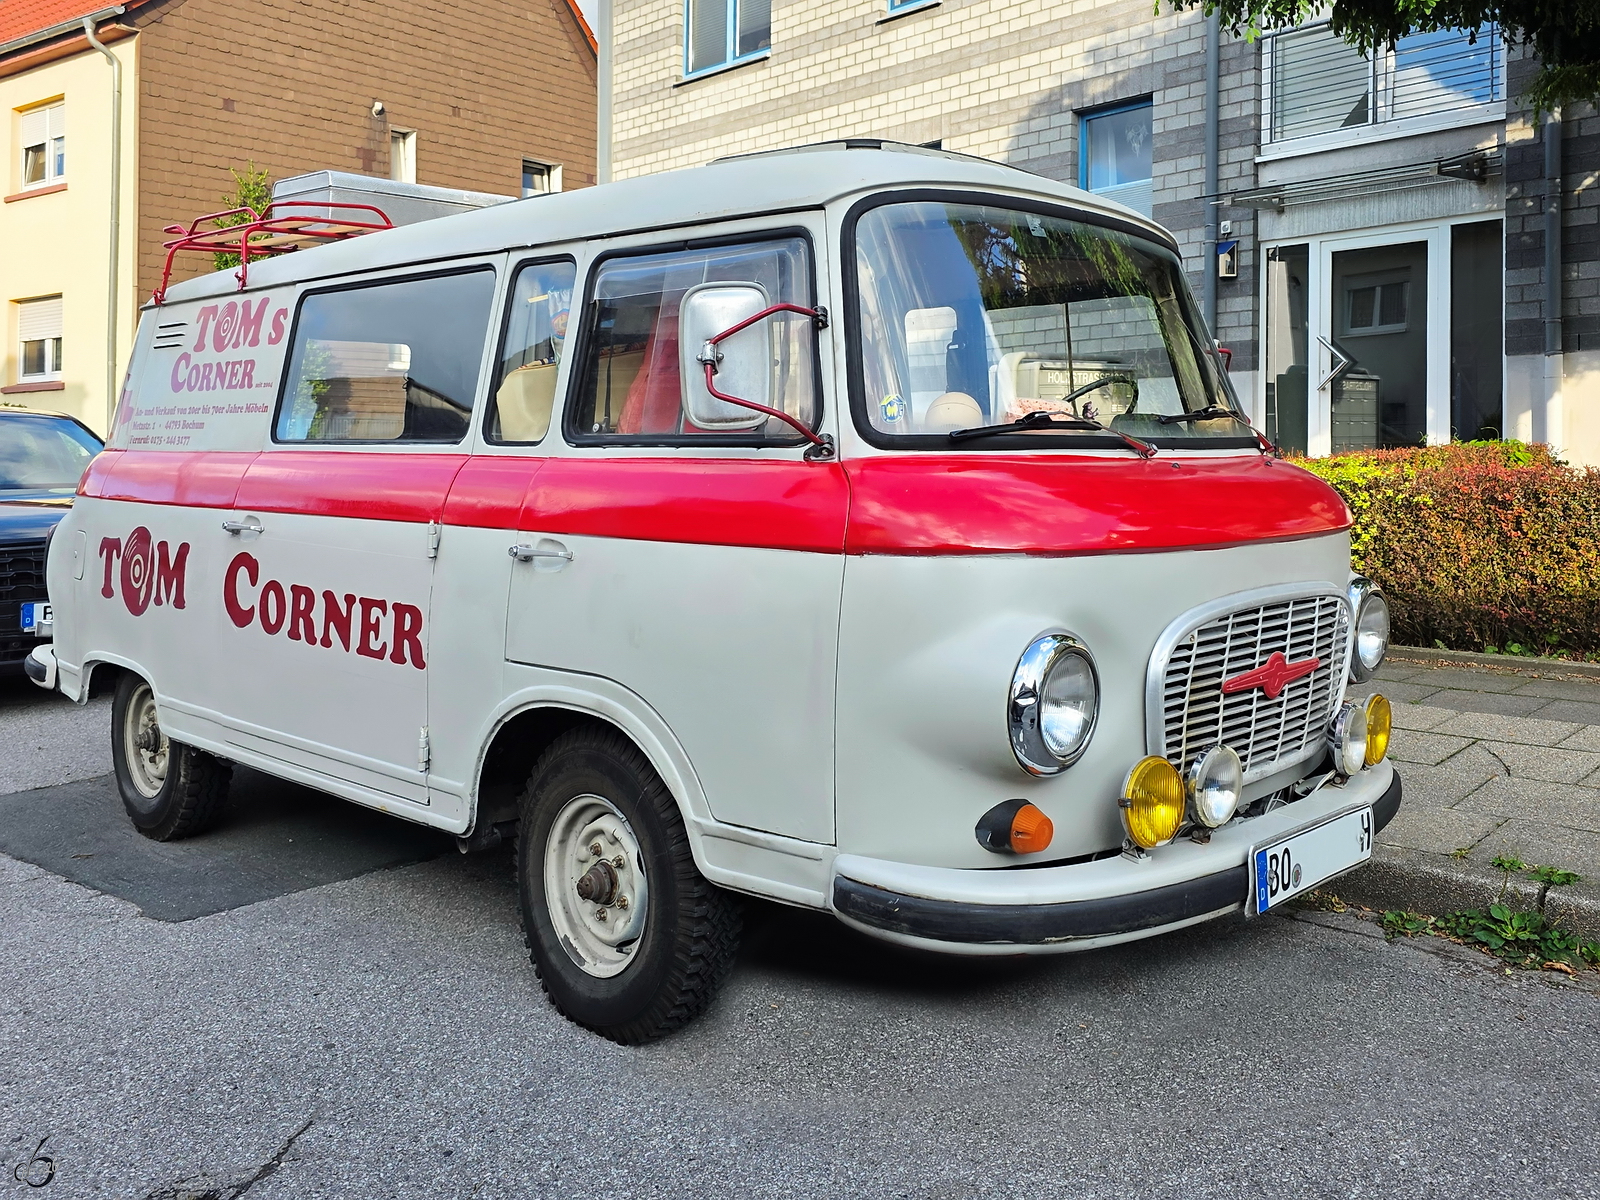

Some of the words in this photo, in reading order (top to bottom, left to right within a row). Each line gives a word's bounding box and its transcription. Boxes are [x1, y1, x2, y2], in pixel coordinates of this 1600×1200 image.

[170, 352, 256, 393] CORNER
[144, 407, 155, 416] und
[155, 405, 177, 416] Verkauf
[177, 407, 187, 415] von
[201, 404, 211, 415] bis
[225, 403, 244, 414] Jahre
[244, 402, 269, 413] Möbeln
[181, 419, 205, 430] Bochum
[98, 525, 191, 617] TOM
[223, 551, 426, 671] CORNER
[1269, 847, 1291, 898] BO
